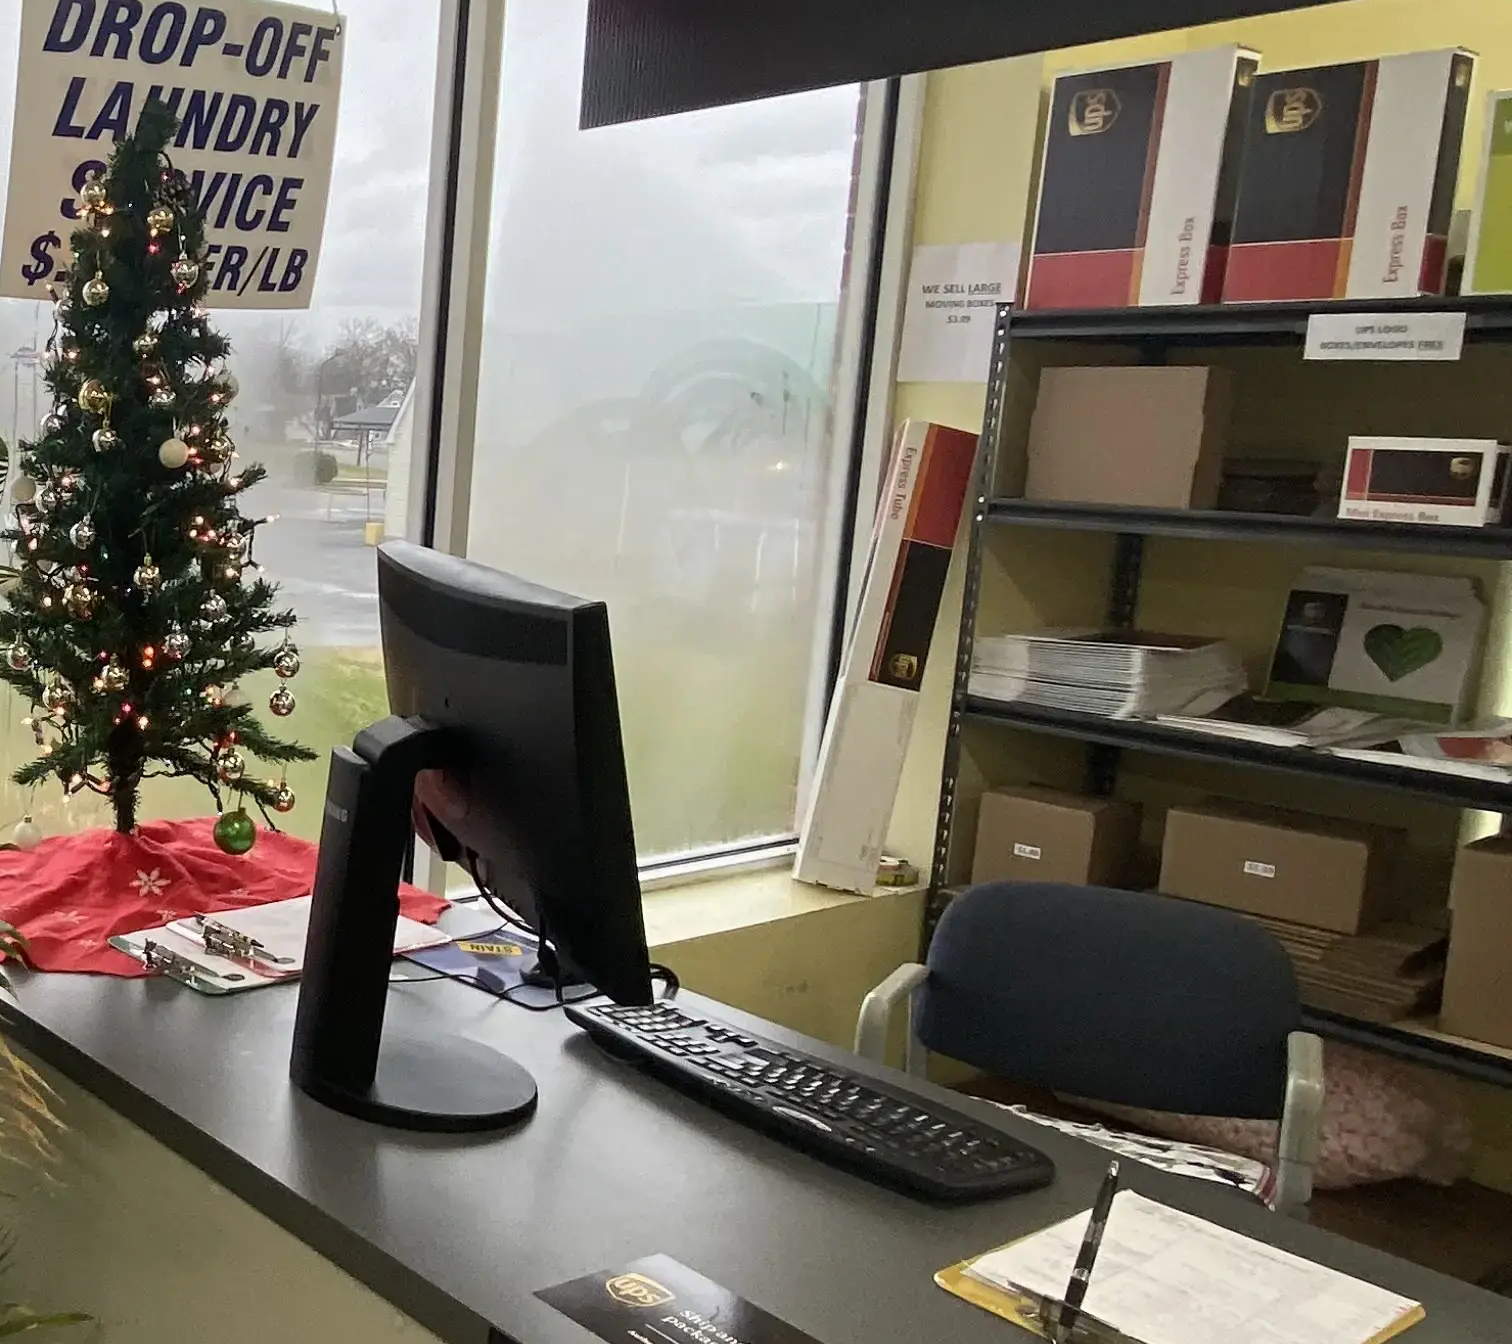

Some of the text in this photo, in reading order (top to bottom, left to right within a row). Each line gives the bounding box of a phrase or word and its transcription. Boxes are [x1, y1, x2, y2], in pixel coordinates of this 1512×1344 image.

[60, 159, 305, 233] SVICE
[1171, 216, 1196, 295] Express Box
[1382, 205, 1409, 284] Express Box
[921, 282, 1002, 294] WE SELL LARGE
[925, 300, 965, 309] MOVING
[890, 447, 918, 520] Express Tube
[613, 1276, 662, 1304] ups
[679, 1309, 717, 1333] Ship
